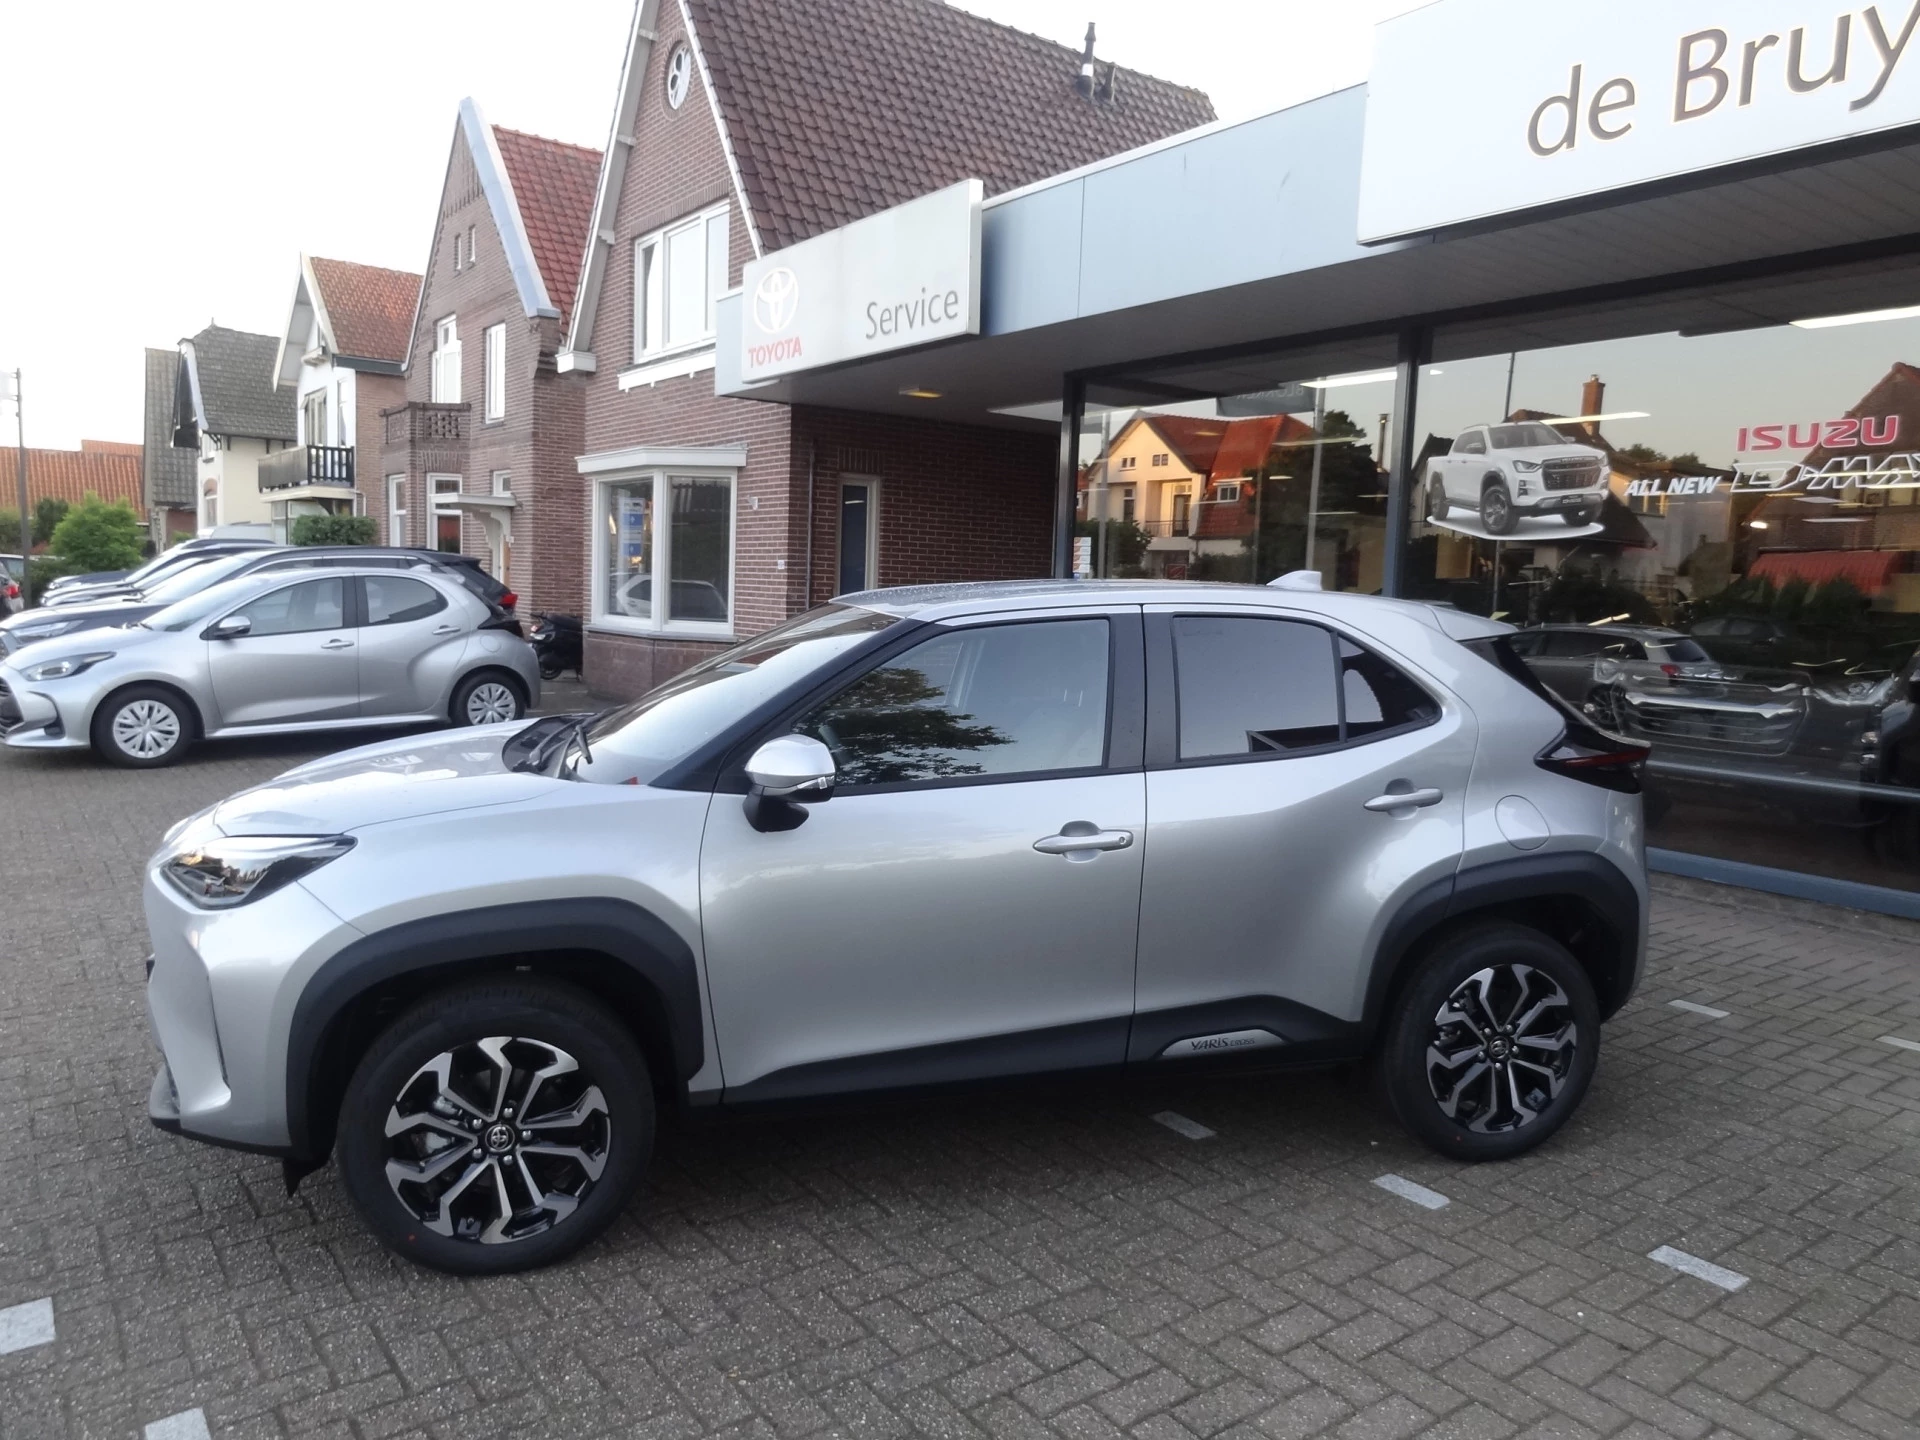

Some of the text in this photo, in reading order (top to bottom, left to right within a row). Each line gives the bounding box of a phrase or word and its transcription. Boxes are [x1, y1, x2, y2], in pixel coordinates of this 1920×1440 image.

[1527, 0, 1920, 156] de Bruy
[866, 287, 959, 340] Service
[748, 336, 803, 368] TOYOTA
[1736, 415, 1899, 452] ISUZU
[1624, 453, 1920, 497] ALL NEW D-MA
[1190, 1037, 1229, 1051] YARIS
